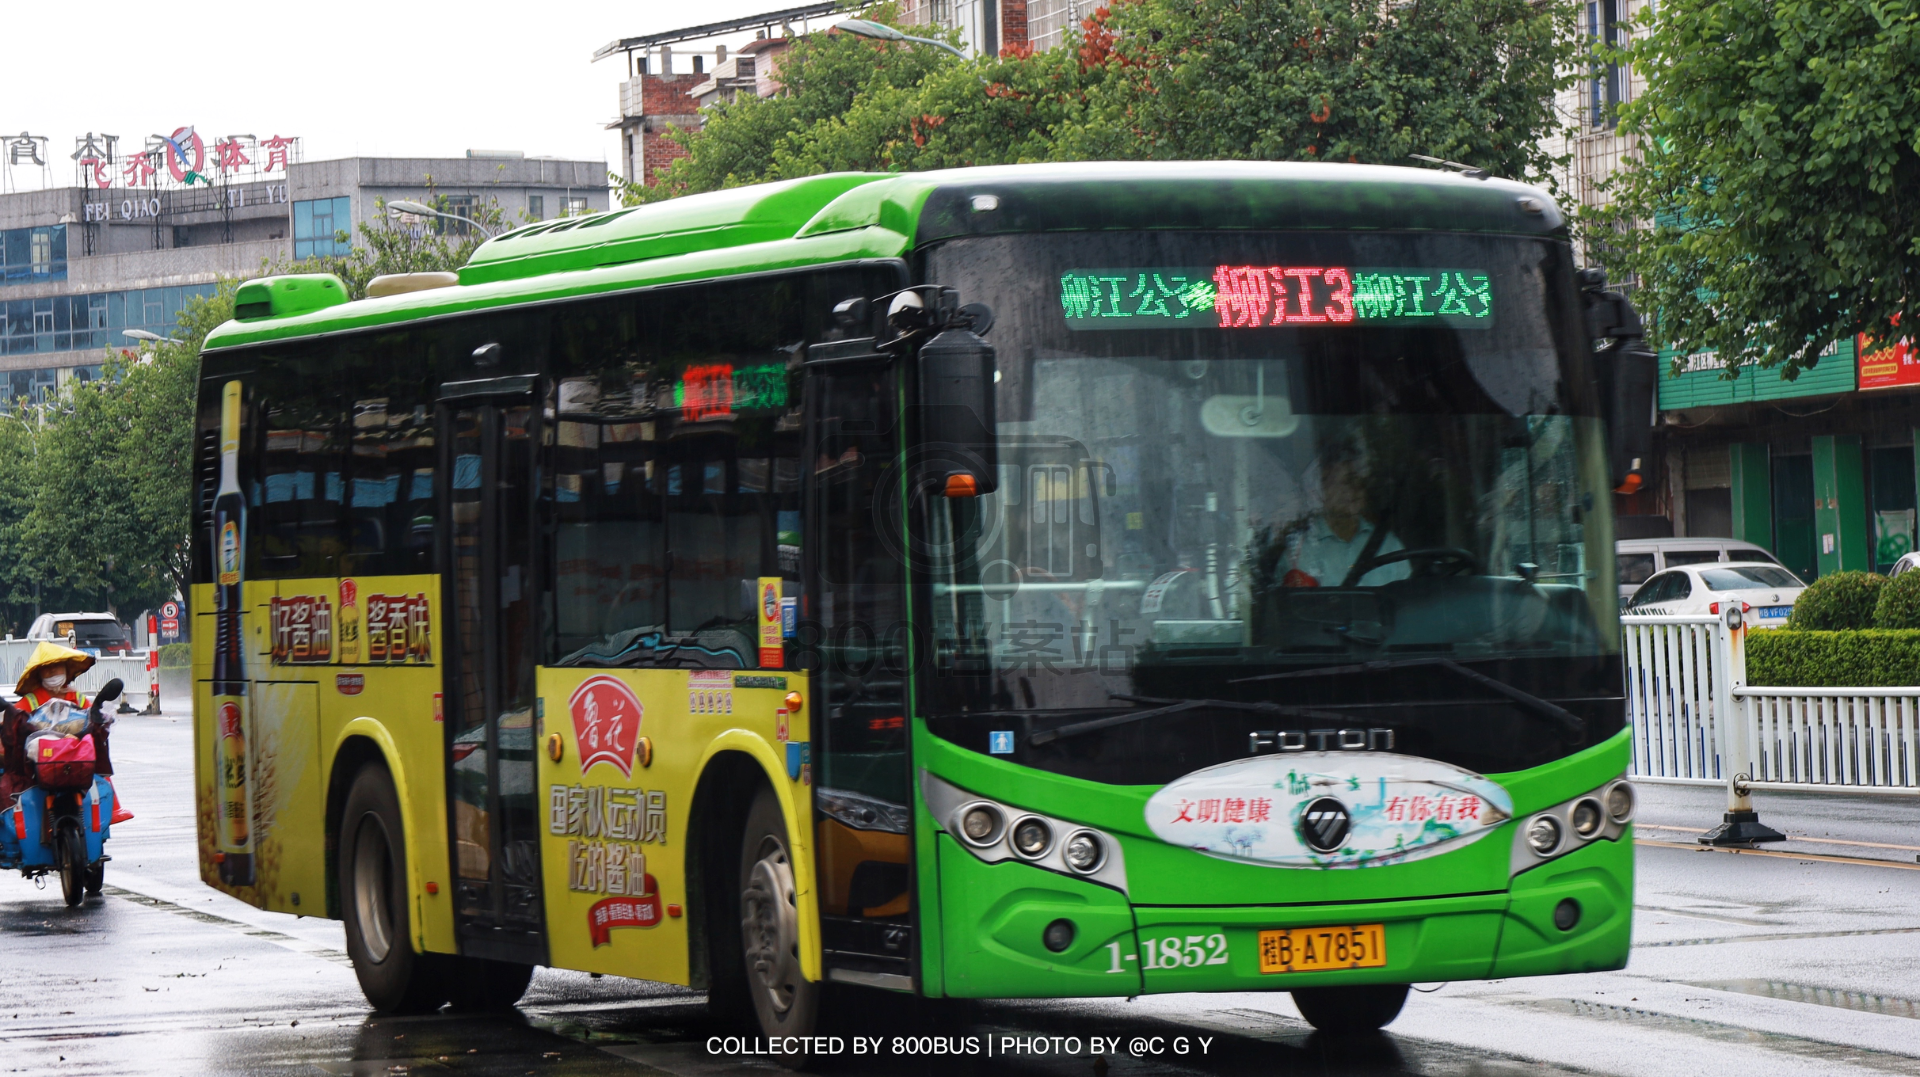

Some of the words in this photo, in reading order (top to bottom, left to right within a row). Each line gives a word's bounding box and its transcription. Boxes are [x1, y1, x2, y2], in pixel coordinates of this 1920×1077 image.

[85, 202, 110, 222] FEI
[121, 198, 161, 221] QIAO
[227, 187, 246, 208] TI
[266, 184, 288, 204] YU
[1213, 265, 1353, 328] 柳江3
[166, 605, 174, 616] 5
[270, 597, 333, 663] 好酱油
[367, 594, 432, 664] 酱香味
[579, 690, 626, 752] 鲁花
[1249, 728, 1395, 753] FOTON
[550, 783, 667, 844] 国家队运动员
[1171, 796, 1273, 825] 文明健康
[1383, 795, 1482, 823] 有你有我
[568, 840, 647, 896] 吃的酱油
[1105, 933, 1229, 974] 1-1852
